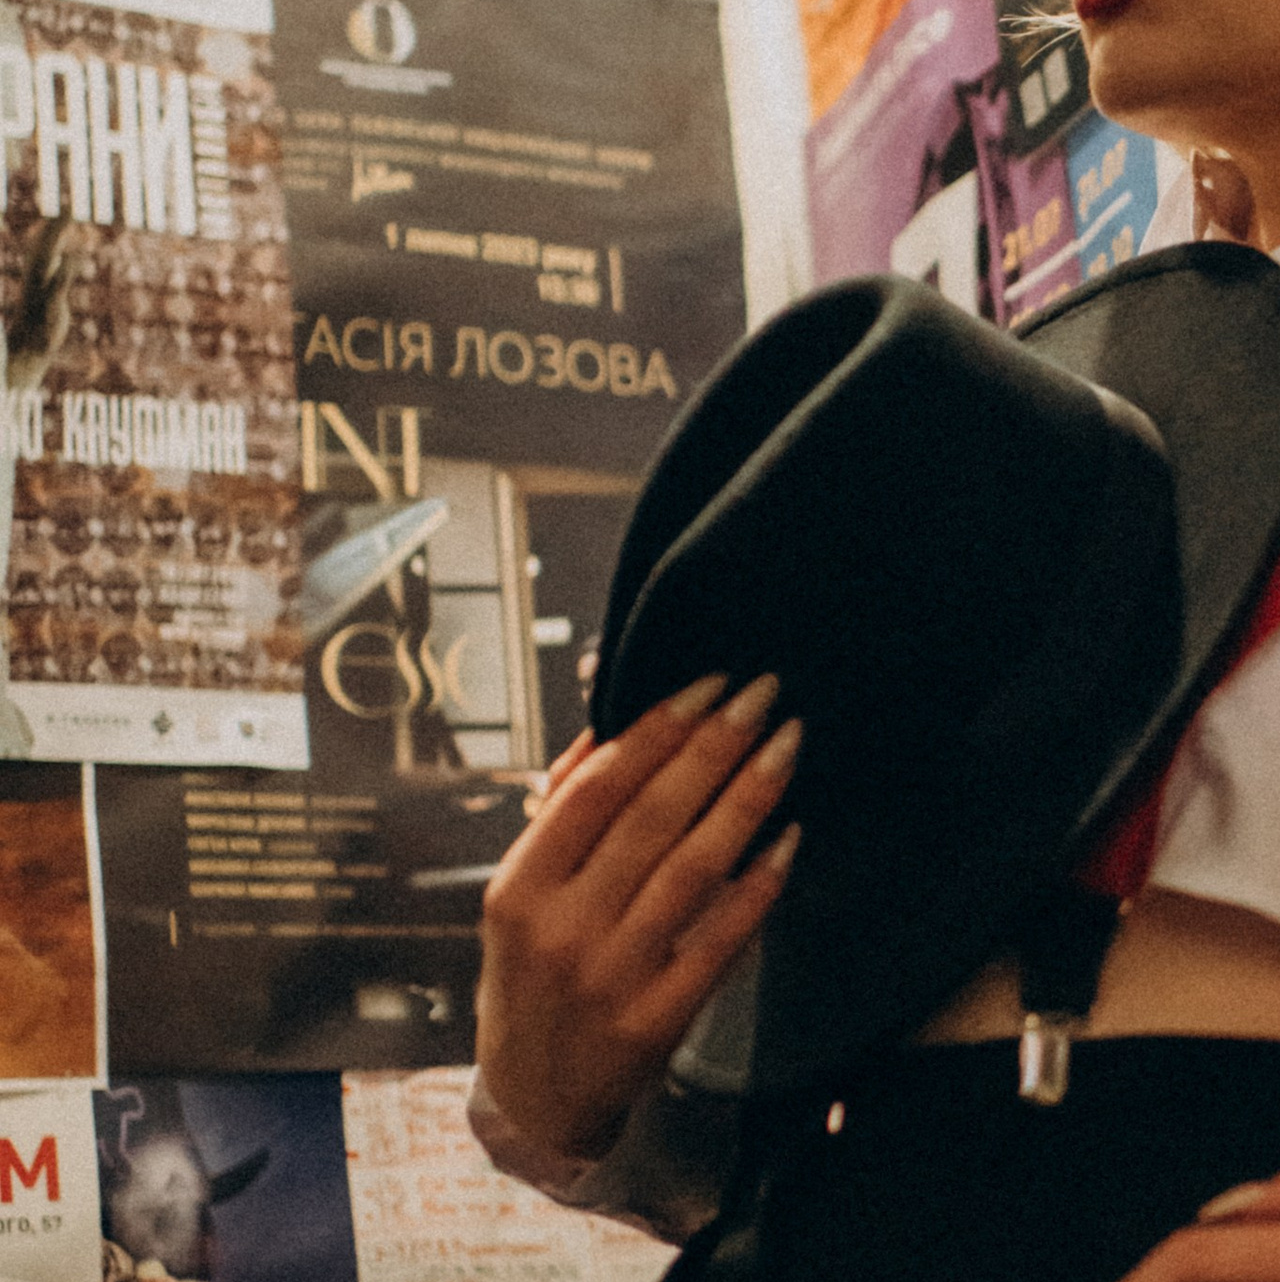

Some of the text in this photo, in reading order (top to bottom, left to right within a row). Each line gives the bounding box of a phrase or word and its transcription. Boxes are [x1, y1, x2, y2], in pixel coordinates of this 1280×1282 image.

[297, 311, 681, 401] АСІЯ ЛОЗОВА
[62, 390, 247, 474] КАУФМАН
